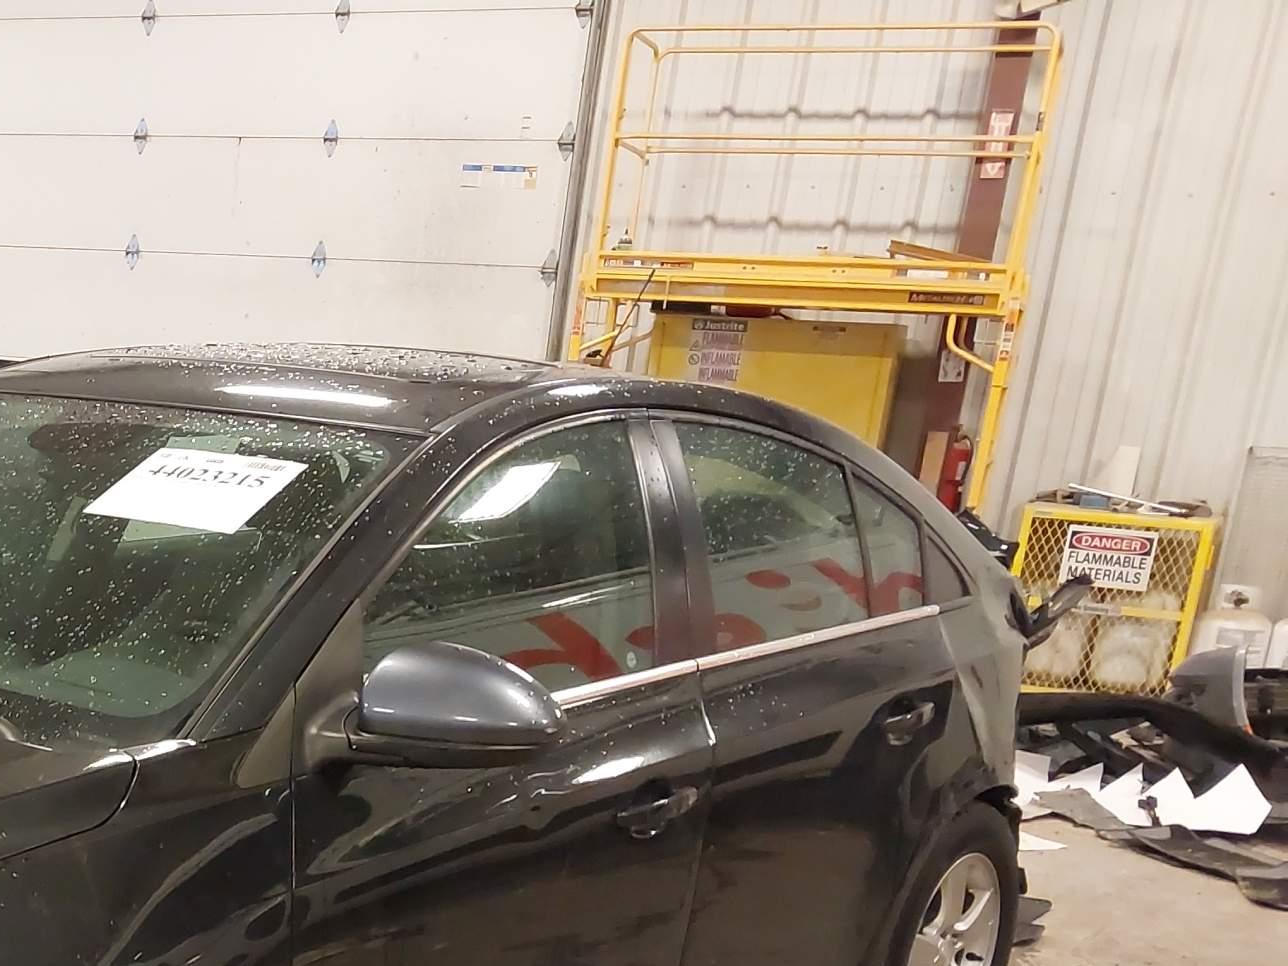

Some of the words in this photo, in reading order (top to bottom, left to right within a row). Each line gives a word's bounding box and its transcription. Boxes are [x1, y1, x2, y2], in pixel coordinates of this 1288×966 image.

[148, 464, 271, 489] 44023215
[1081, 535, 1142, 552] DANGER
[1067, 551, 1148, 570] FLAMMABLE
[1066, 565, 1142, 585] MATERIALS
